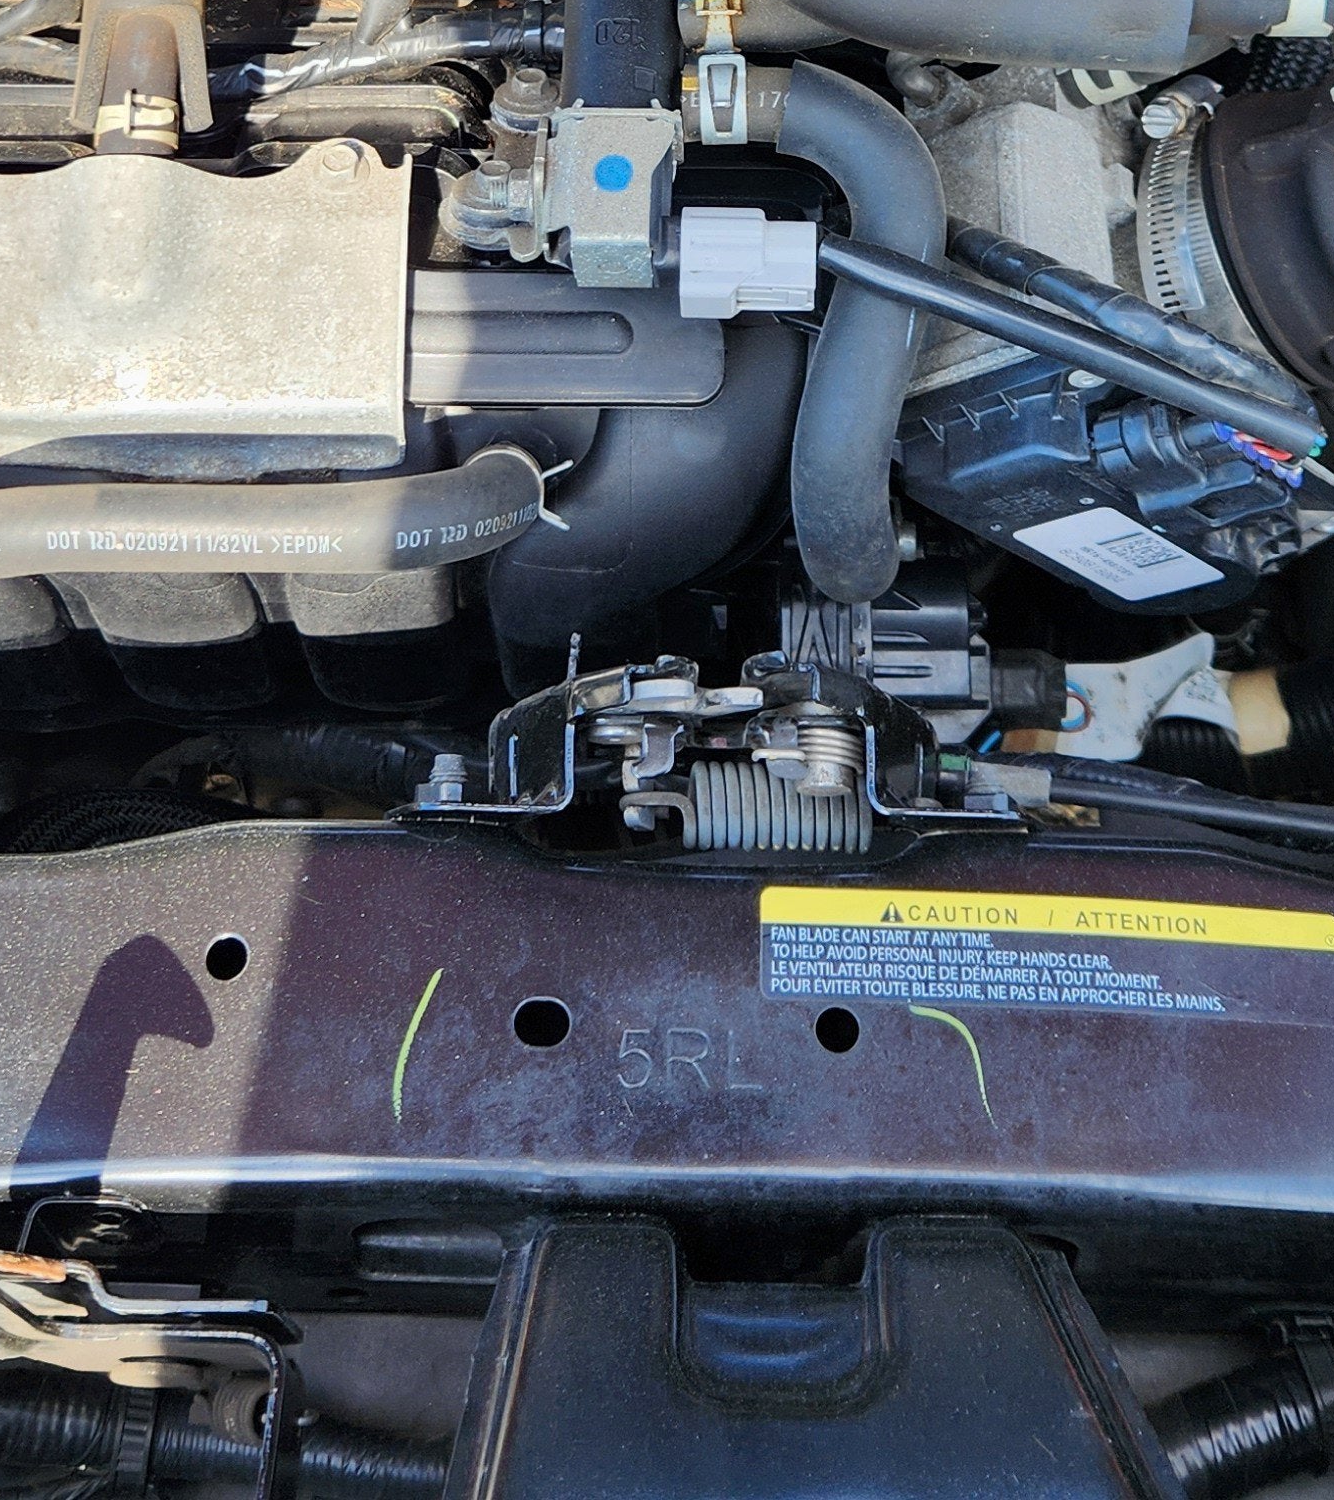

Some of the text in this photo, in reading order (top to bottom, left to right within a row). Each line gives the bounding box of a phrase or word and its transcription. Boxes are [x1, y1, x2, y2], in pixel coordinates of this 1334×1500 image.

[46, 530, 81, 550] DOT
[124, 532, 189, 552] 020921
[195, 533, 265, 554] 11/32VL
[270, 533, 344, 555] >EPDM<
[395, 528, 434, 550] DOT
[907, 904, 1018, 925] CAUTION
[1075, 910, 1208, 936] ATTENTION
[771, 925, 995, 948] FAN BLADE CAN START AT ANY TIME.
[772, 943, 1113, 970] TO HELP AVOID PERSONAL INJURY, KEEP HANDS CLEAR.
[771, 961, 1164, 991] LE VENTILATEUR RISQUE DE DÉMARRER À TOUT MOMENT.
[771, 977, 1226, 1013] POUR ÉVITER TOUTE BLESSURE, NE PAS EN APPROCHER LES MAINS.
[617, 1027, 764, 1090] 5RL
